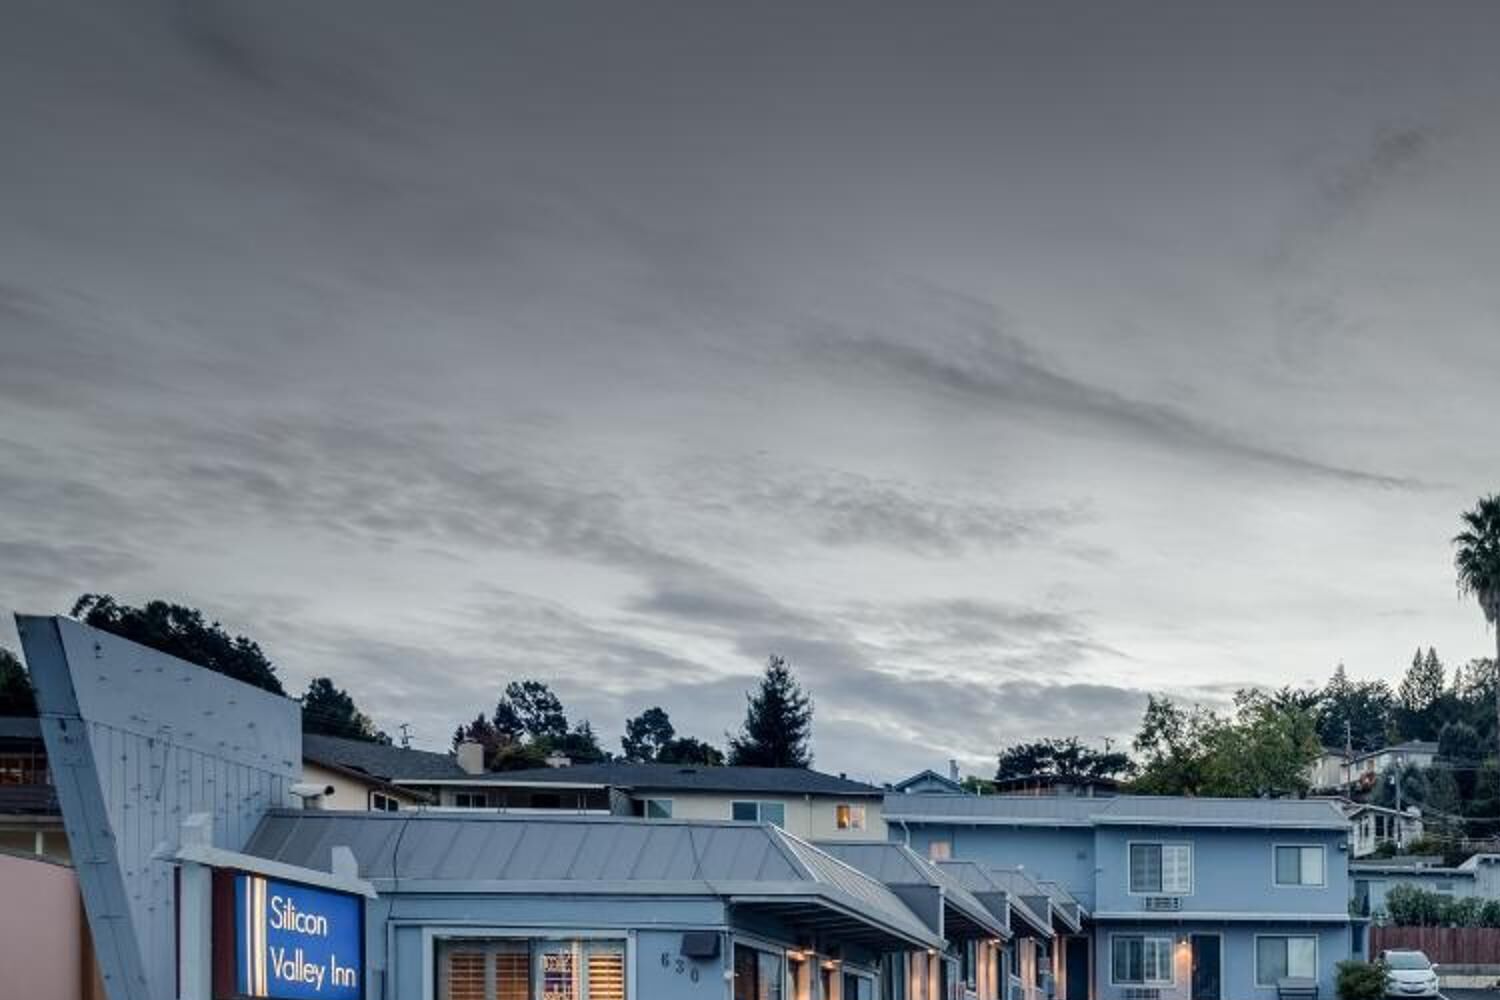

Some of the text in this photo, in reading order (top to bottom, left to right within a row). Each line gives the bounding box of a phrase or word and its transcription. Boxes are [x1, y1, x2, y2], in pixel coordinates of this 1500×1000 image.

[269, 895, 328, 937] Silicon
[268, 945, 357, 991] Valley Inn
[661, 952, 699, 983] 630
